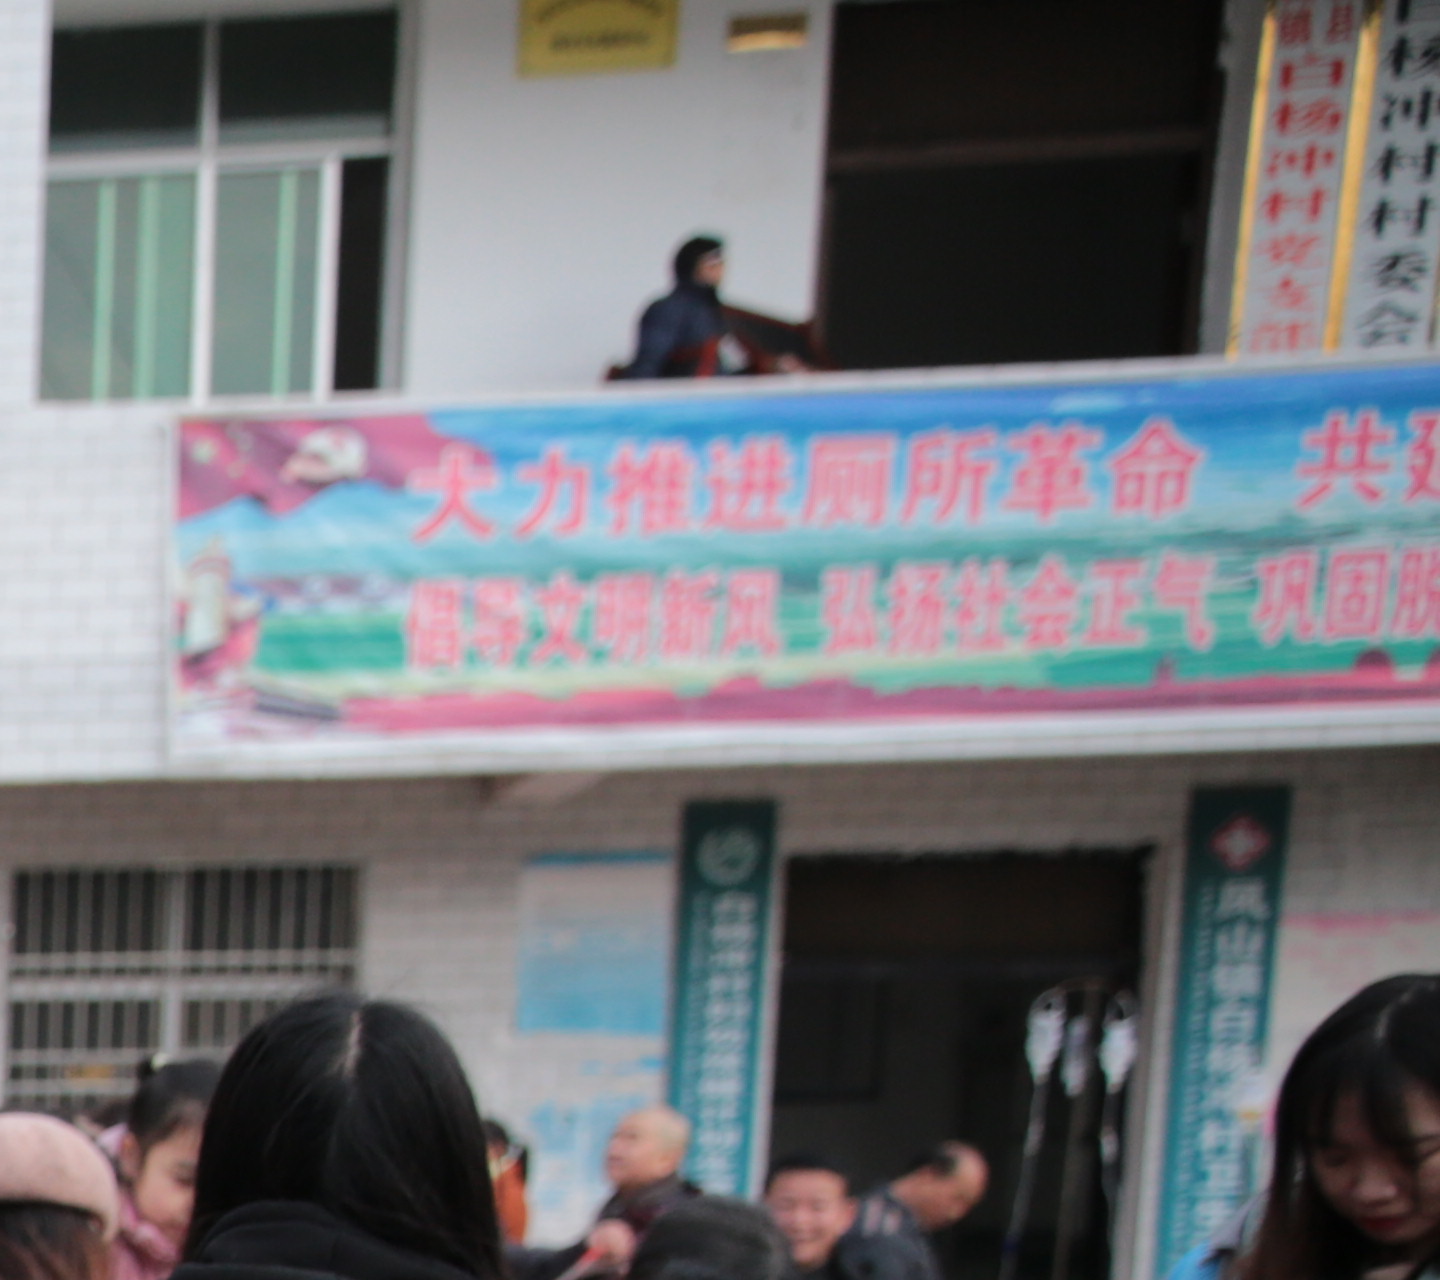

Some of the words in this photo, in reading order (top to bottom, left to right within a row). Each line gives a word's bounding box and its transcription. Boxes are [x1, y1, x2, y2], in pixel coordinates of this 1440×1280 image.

[406, 416, 1204, 541] 大力推进厕所革命
[821, 552, 1213, 656] 弘扬社会正气
